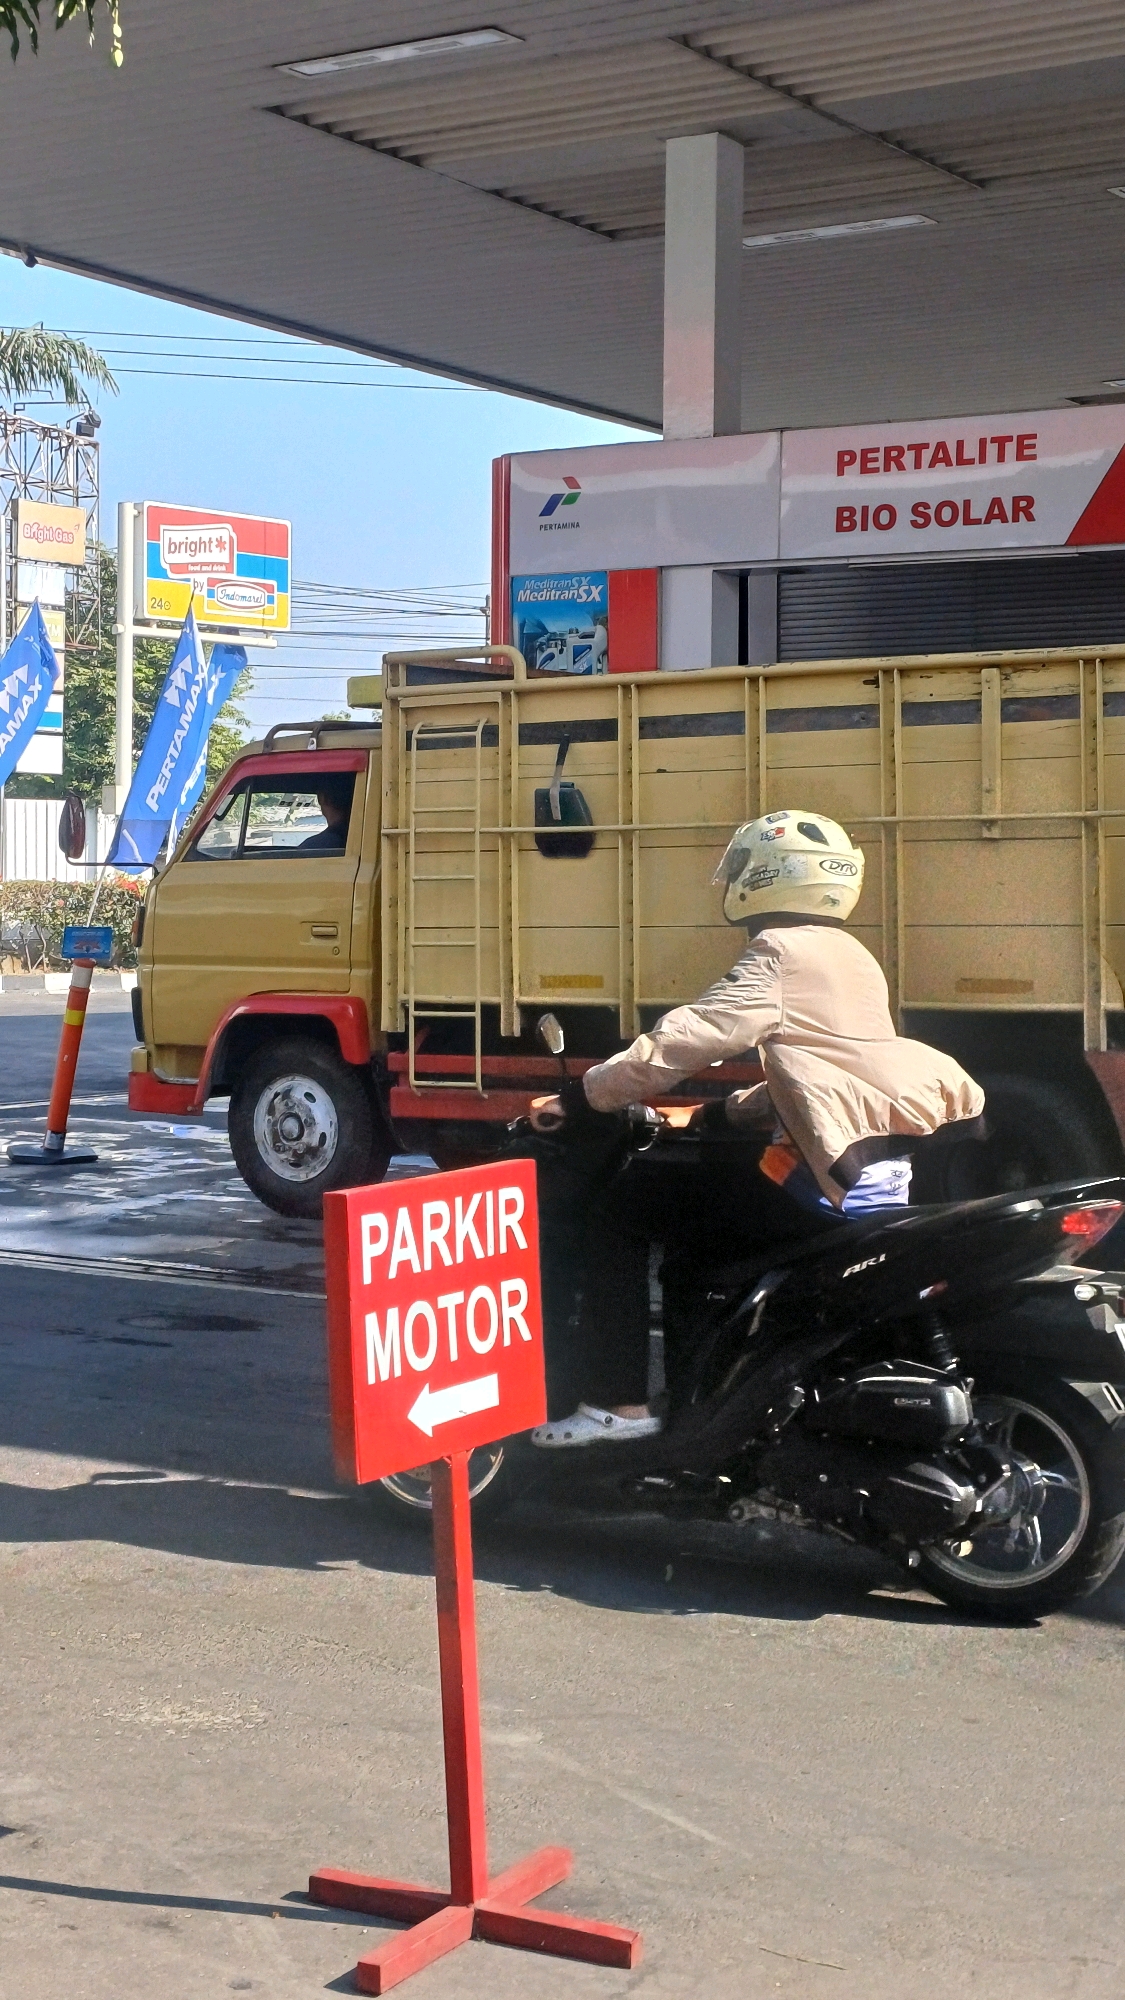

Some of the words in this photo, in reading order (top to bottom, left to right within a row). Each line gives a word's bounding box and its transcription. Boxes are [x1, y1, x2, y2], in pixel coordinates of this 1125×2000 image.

[836, 433, 1038, 477] PERTALITE
[23, 521, 54, 544] Bright
[55, 527, 74, 544] Gas
[539, 521, 581, 531] PERTAMINA
[835, 503, 898, 533] BIO
[909, 495, 1037, 530] SOLAR
[201, 564, 212, 572] and
[219, 588, 263, 604] Indomaret
[146, 661, 206, 813] PERTAMAX
[360, 1186, 529, 1286] PARKIR
[364, 1277, 533, 1386] MOTOR
